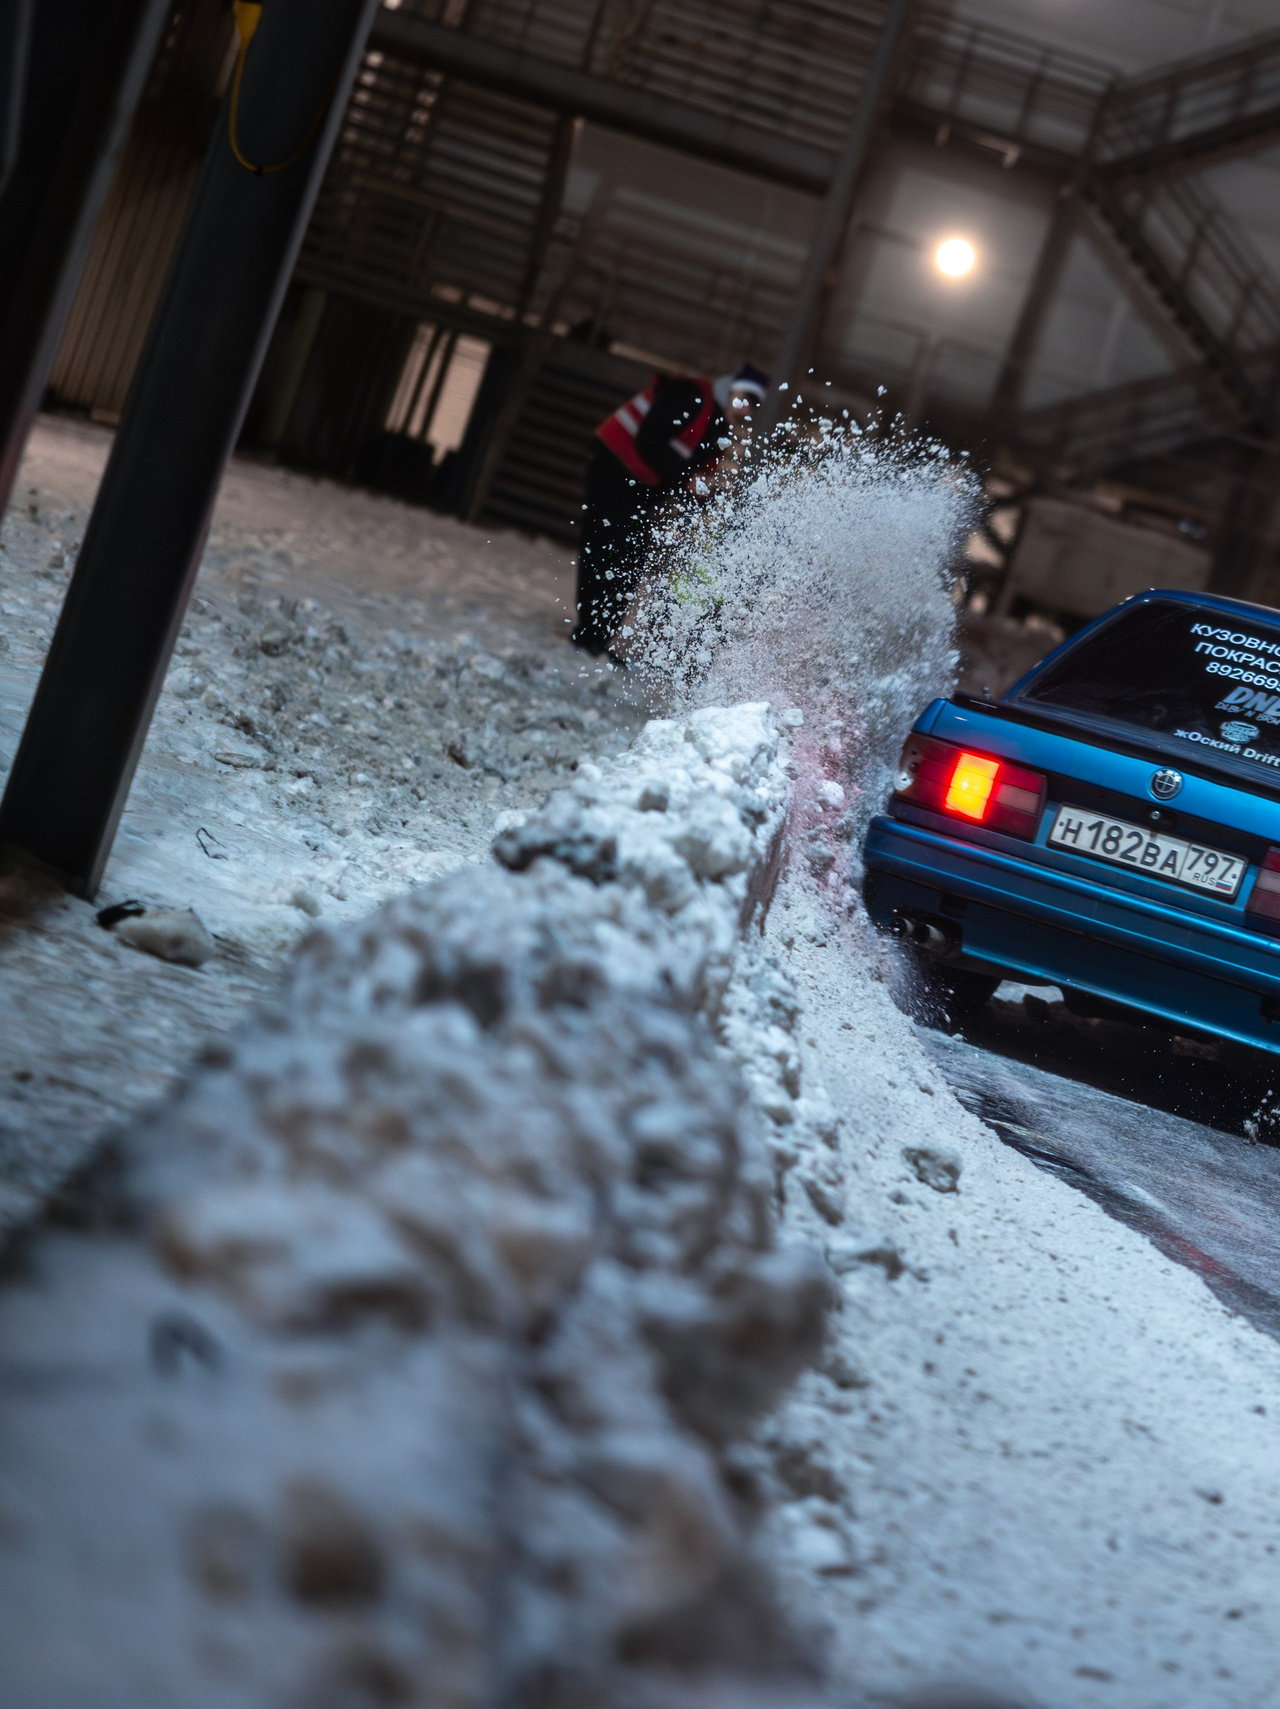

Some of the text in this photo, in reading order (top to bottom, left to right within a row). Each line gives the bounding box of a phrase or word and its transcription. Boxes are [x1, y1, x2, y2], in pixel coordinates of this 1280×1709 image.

[1173, 729, 1241, 754] жОский
[1187, 847, 1236, 881] 797
[1193, 873, 1215, 886] RUS
